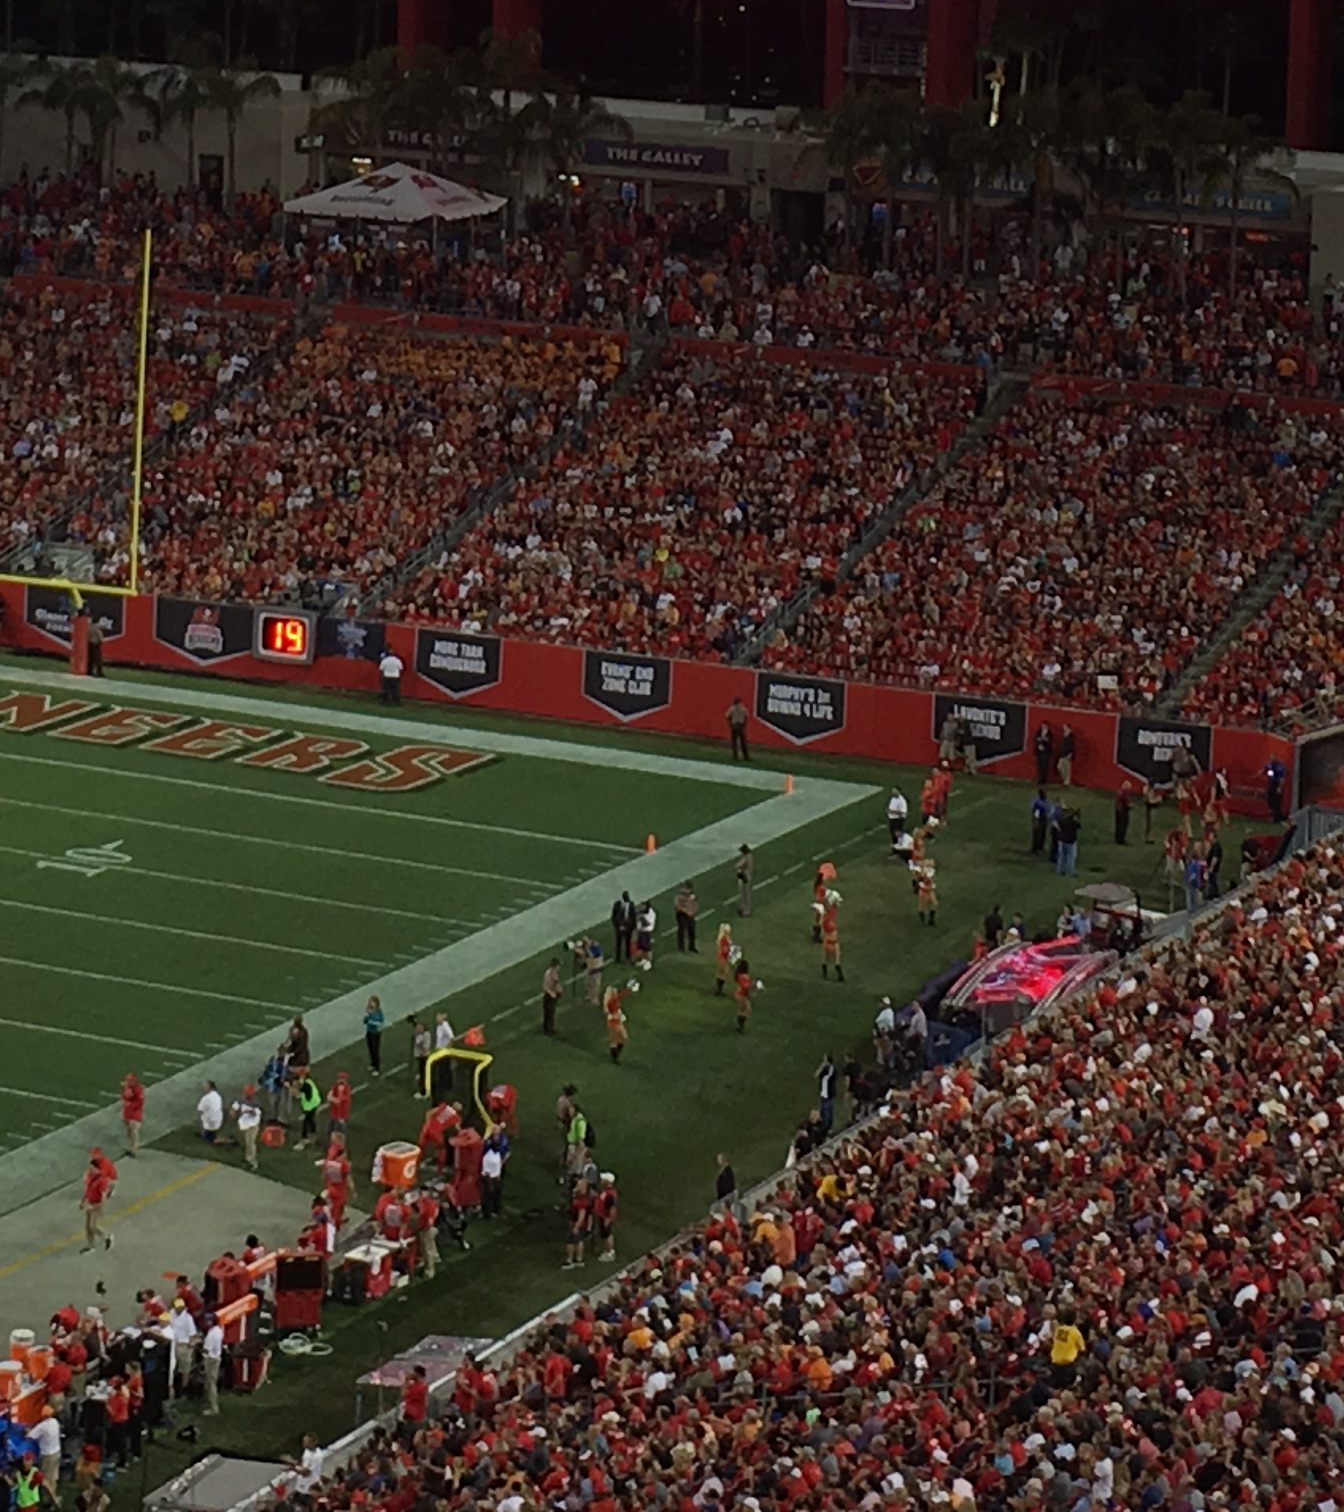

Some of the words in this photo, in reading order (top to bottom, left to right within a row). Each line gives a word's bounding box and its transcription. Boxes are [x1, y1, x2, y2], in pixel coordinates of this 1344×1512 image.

[606, 146, 638, 162] THE
[272, 619, 304, 655] 19
[37, 844, 133, 877] 10
